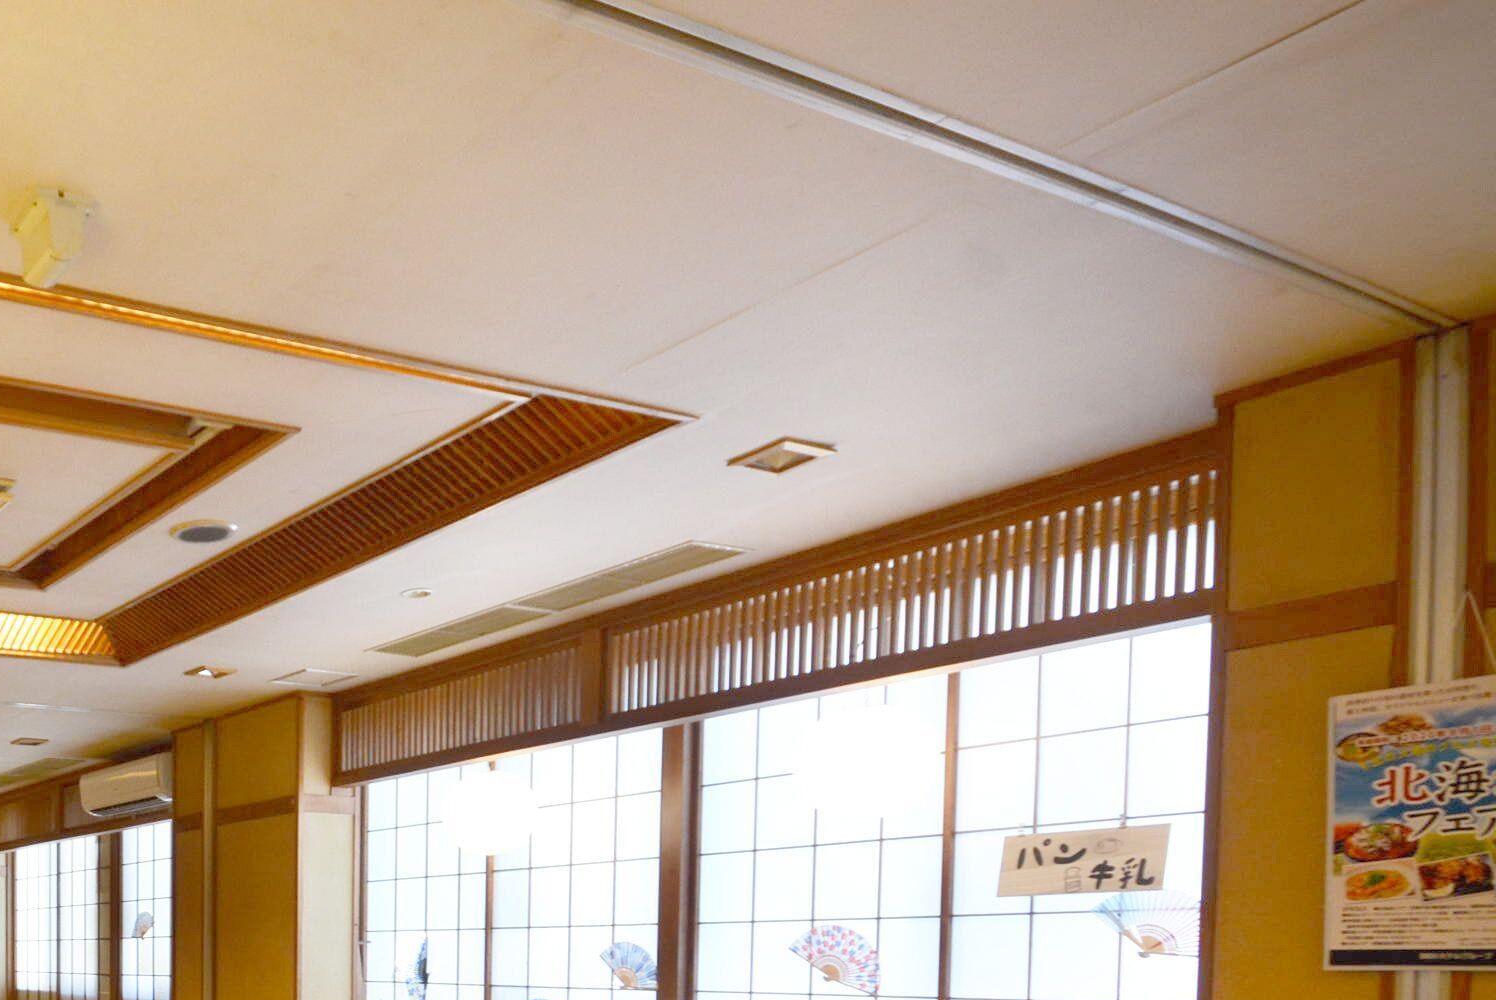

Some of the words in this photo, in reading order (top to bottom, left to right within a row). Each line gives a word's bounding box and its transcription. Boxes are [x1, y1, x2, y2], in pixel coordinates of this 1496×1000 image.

[1373, 759, 1496, 805] 北海
[1016, 838, 1087, 870] パン
[1088, 857, 1155, 890] 牛乳
